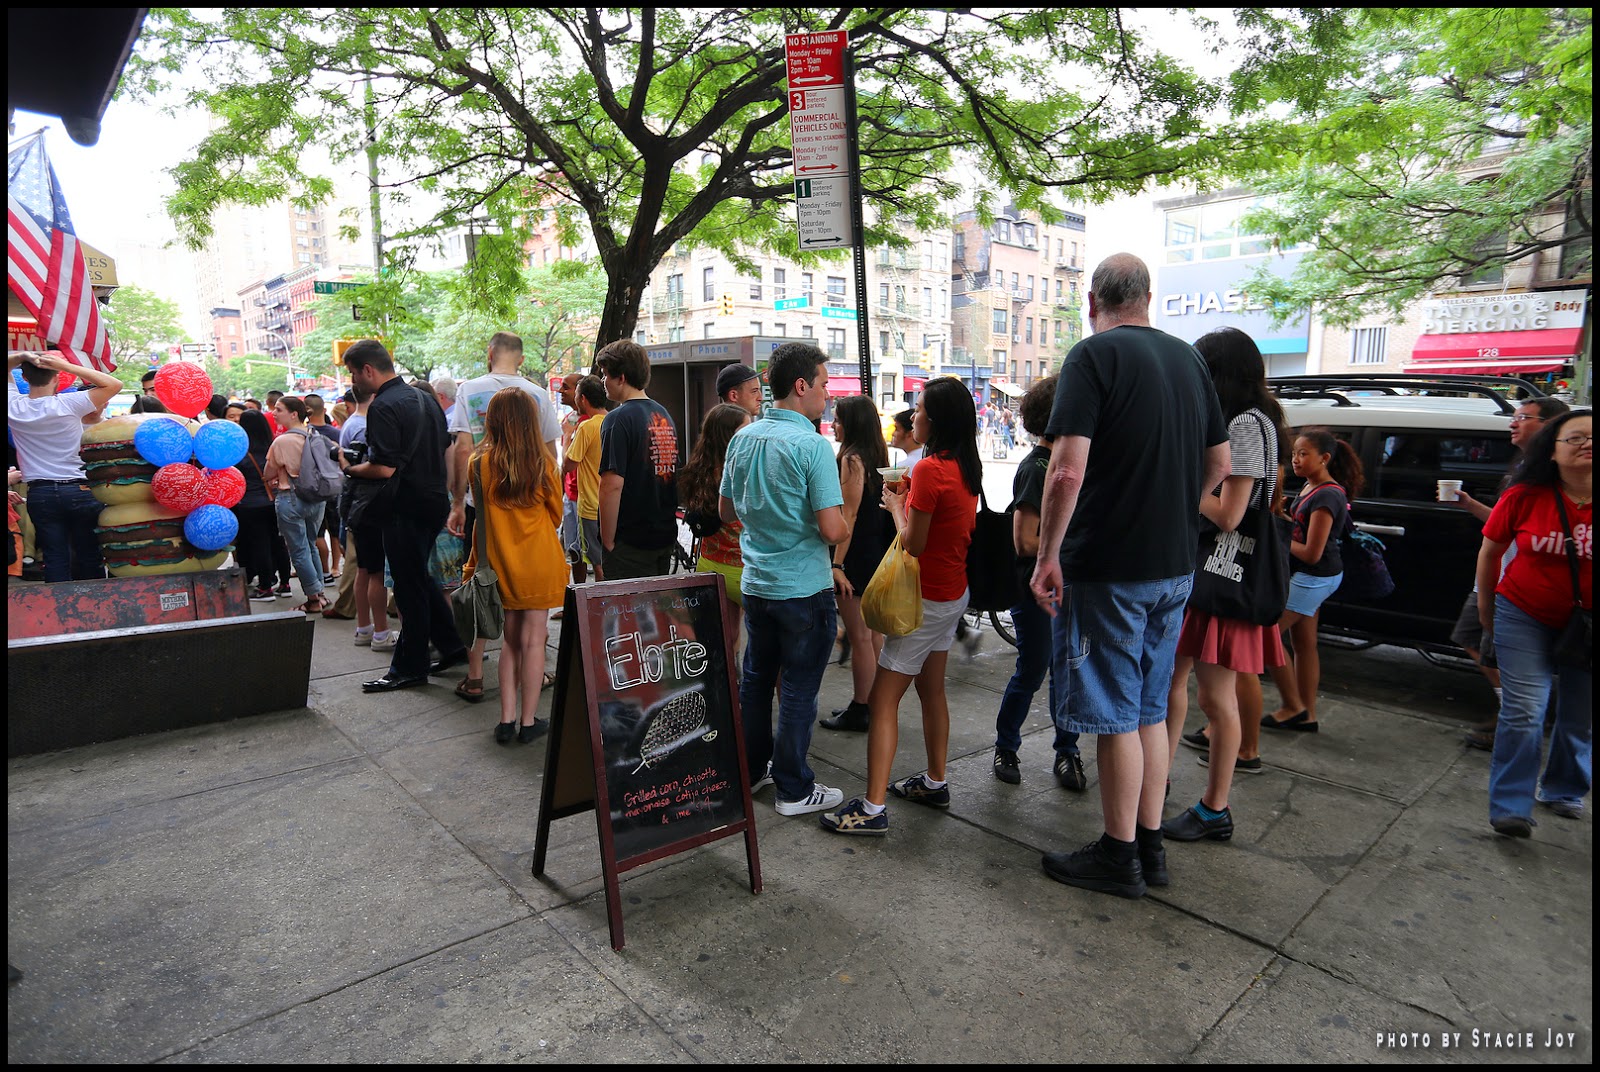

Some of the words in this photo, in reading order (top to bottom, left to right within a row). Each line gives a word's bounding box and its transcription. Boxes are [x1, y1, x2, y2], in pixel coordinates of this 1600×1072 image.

[788, 38, 799, 46] NO
[801, 34, 838, 45] STANDING
[816, 48, 832, 56] Friday
[790, 58, 802, 66] 7am
[793, 93, 803, 110] 3
[794, 113, 840, 123] COMMERCIAL
[795, 123, 827, 133] VEHICLES
[830, 122, 847, 130] ONLY
[800, 181, 806, 197] 1
[85, 257, 108, 268] ES
[317, 282, 327, 292] ST
[1425, 301, 1526, 319] TATTOO
[1554, 301, 1582, 312] Body
[1424, 316, 1548, 335] PIERCING
[648, 351, 673, 359] Phone
[698, 346, 728, 354] Phone
[1477, 348, 1500, 357] 128
[1213, 542, 1239, 562] FILM
[1204, 555, 1244, 582] ARCHIVES
[605, 625, 708, 690] Elote
[624, 786, 657, 807] Grilled
